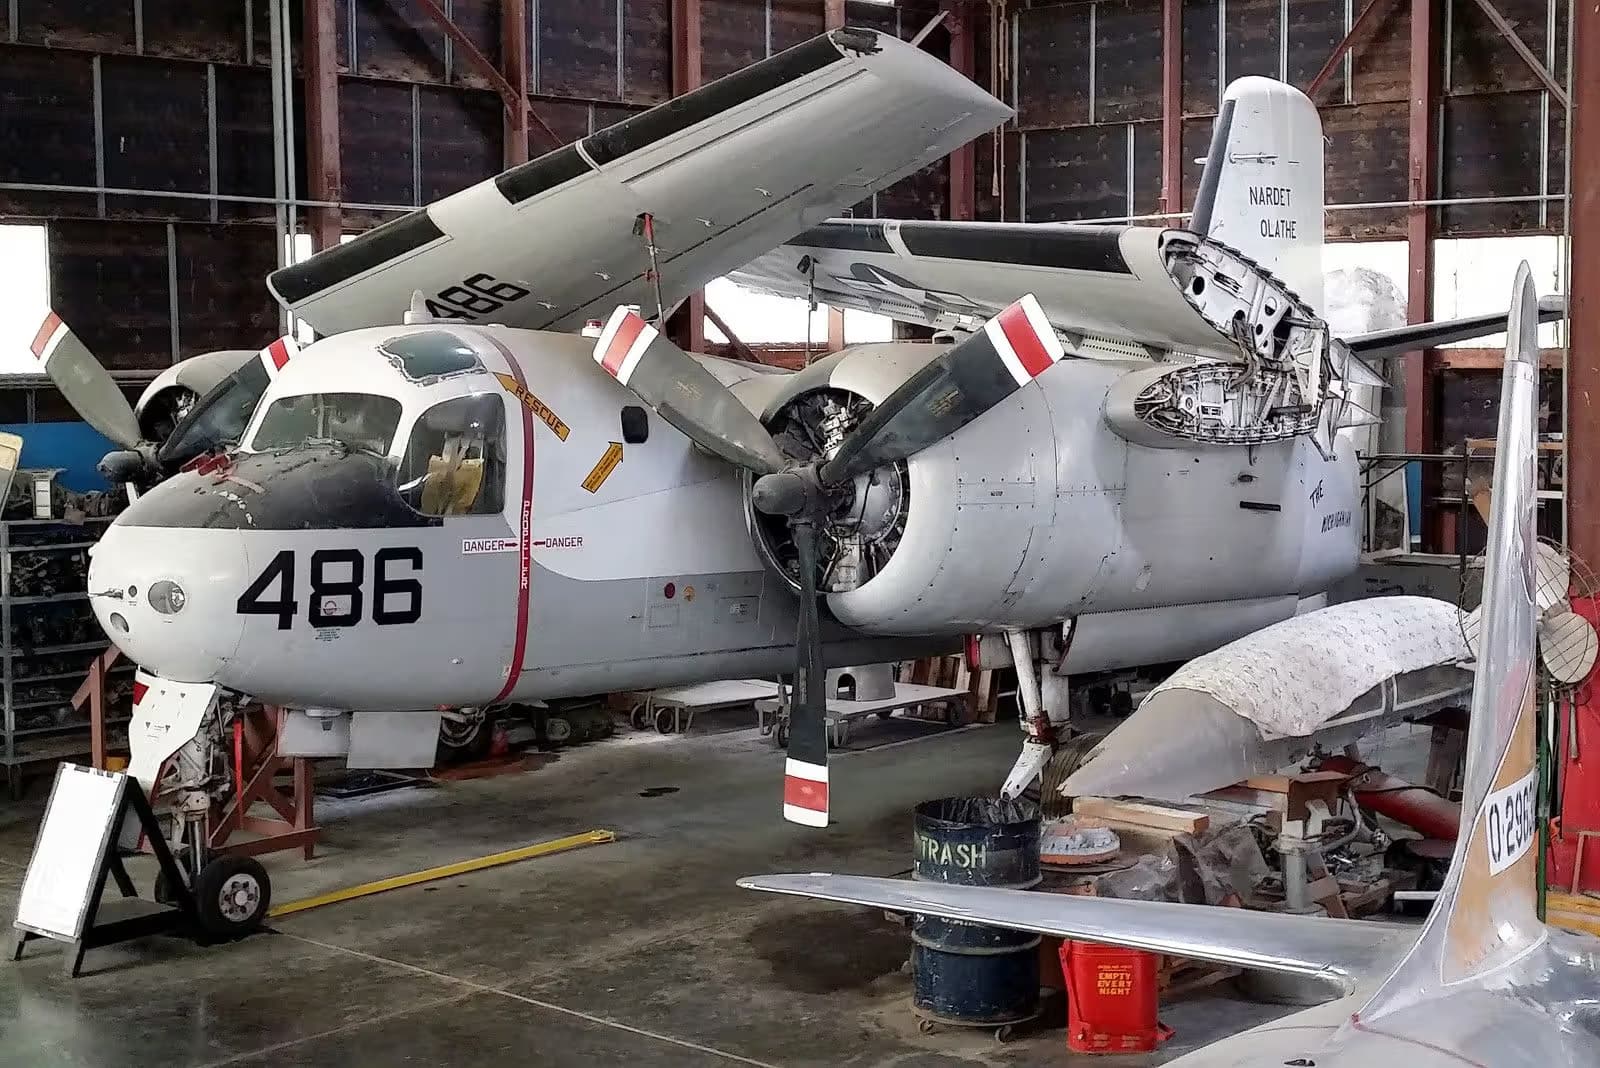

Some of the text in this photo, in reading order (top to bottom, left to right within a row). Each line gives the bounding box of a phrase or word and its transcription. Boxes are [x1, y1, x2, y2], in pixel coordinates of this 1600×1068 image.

[1249, 186, 1291, 207] NARDET
[1260, 218, 1297, 239] OLATHE
[425, 273, 530, 320] 486
[515, 385, 563, 435] RESCUE
[1309, 479, 1324, 509] THE
[463, 540, 504, 552] DANGER
[521, 500, 531, 590] PROPELLER
[545, 537, 584, 548] DANGER
[236, 546, 424, 630] 486
[919, 835, 988, 869] TRASH
[1097, 980, 1133, 988] EVERY
[1099, 972, 1131, 980] EMPTY
[1099, 988, 1131, 996] NIGHT
